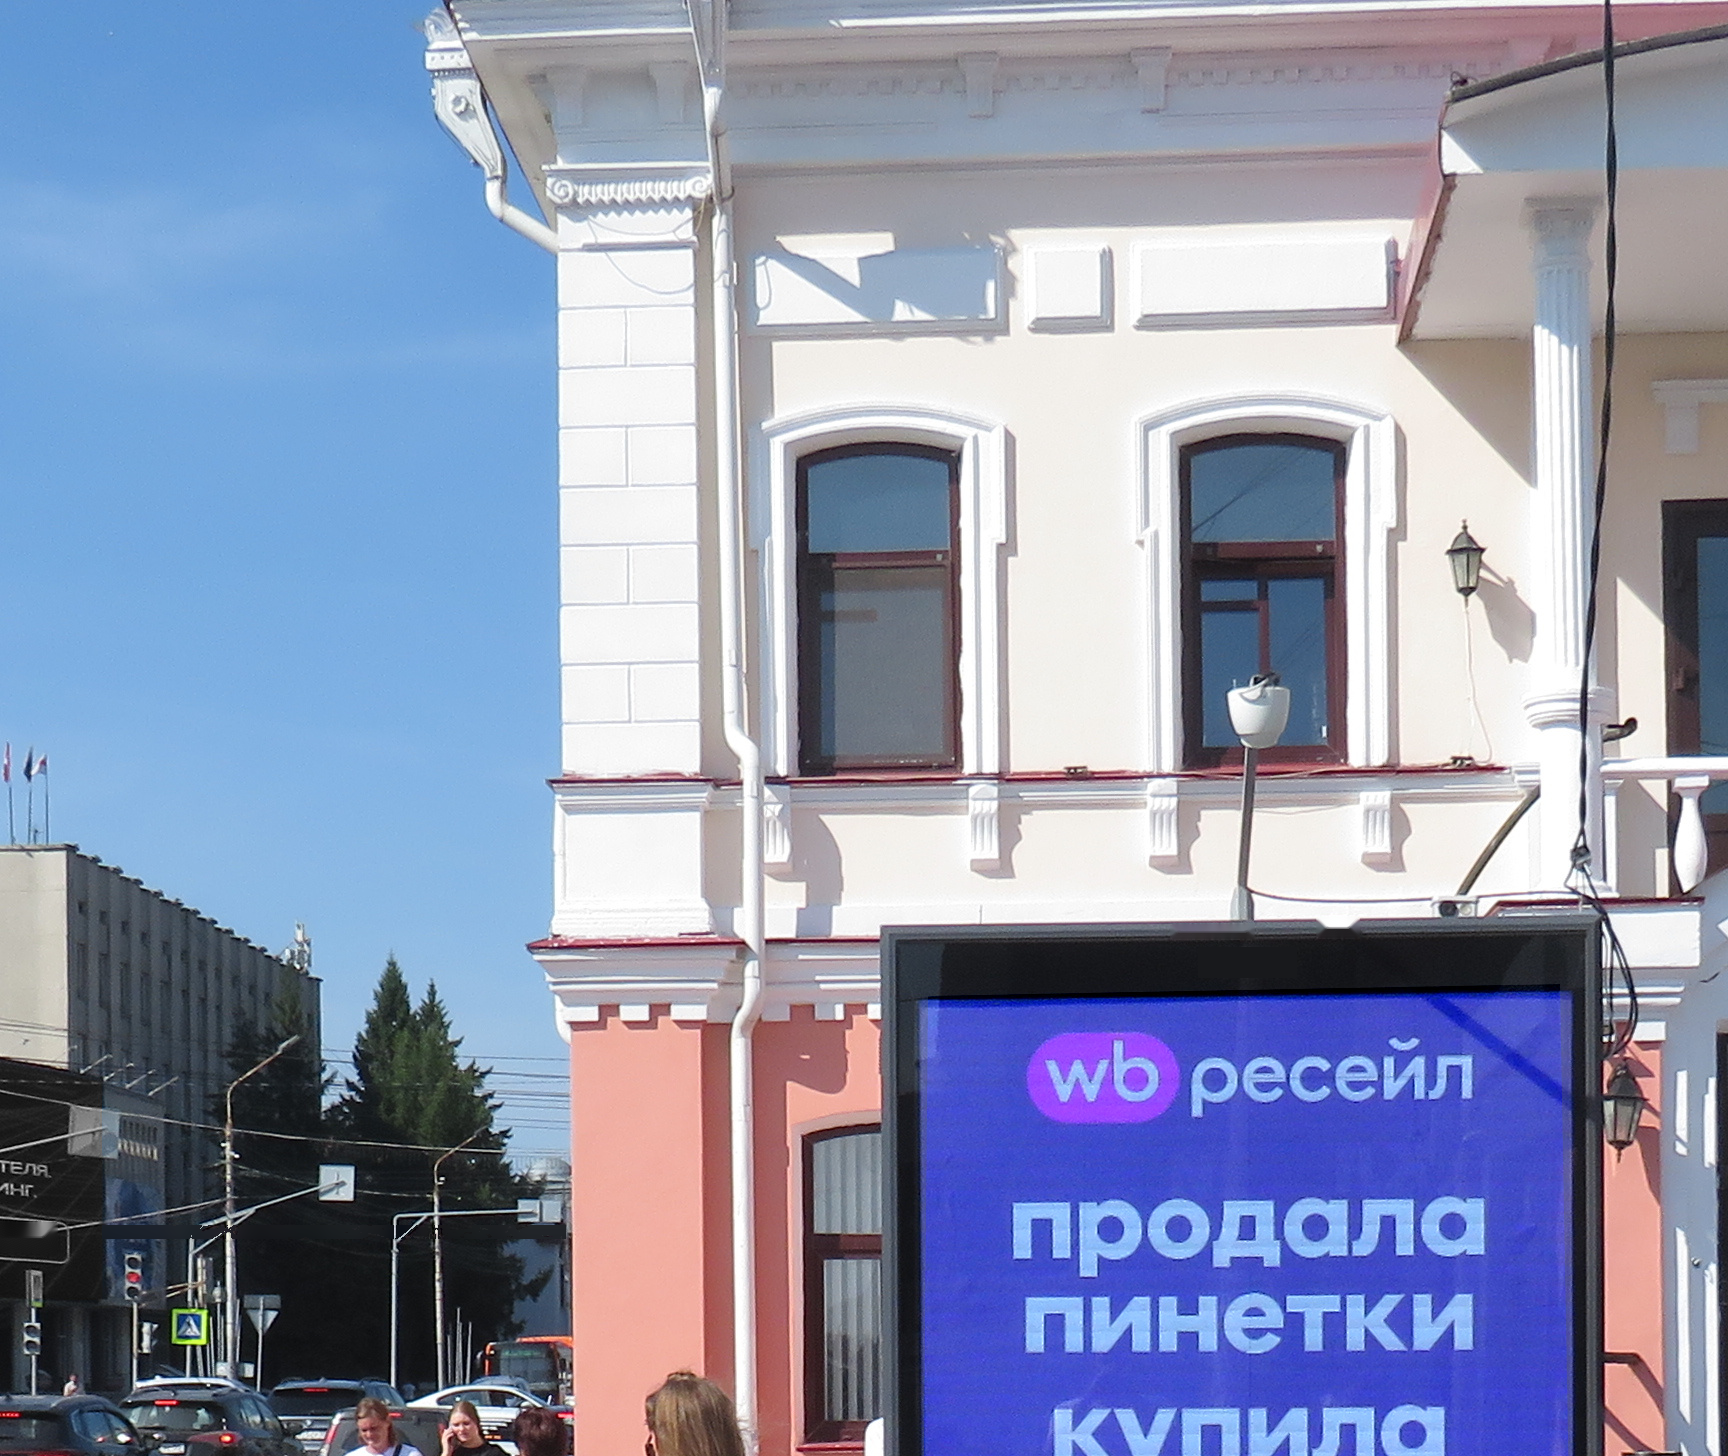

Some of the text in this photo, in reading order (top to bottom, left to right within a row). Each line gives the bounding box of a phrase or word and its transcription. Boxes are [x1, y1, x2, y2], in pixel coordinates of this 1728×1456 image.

[1046, 1040, 1161, 1105] wb
[1191, 1036, 1474, 1117] ресейл
[1011, 1196, 1487, 1278] продала
[1024, 1292, 1473, 1354] пинетки
